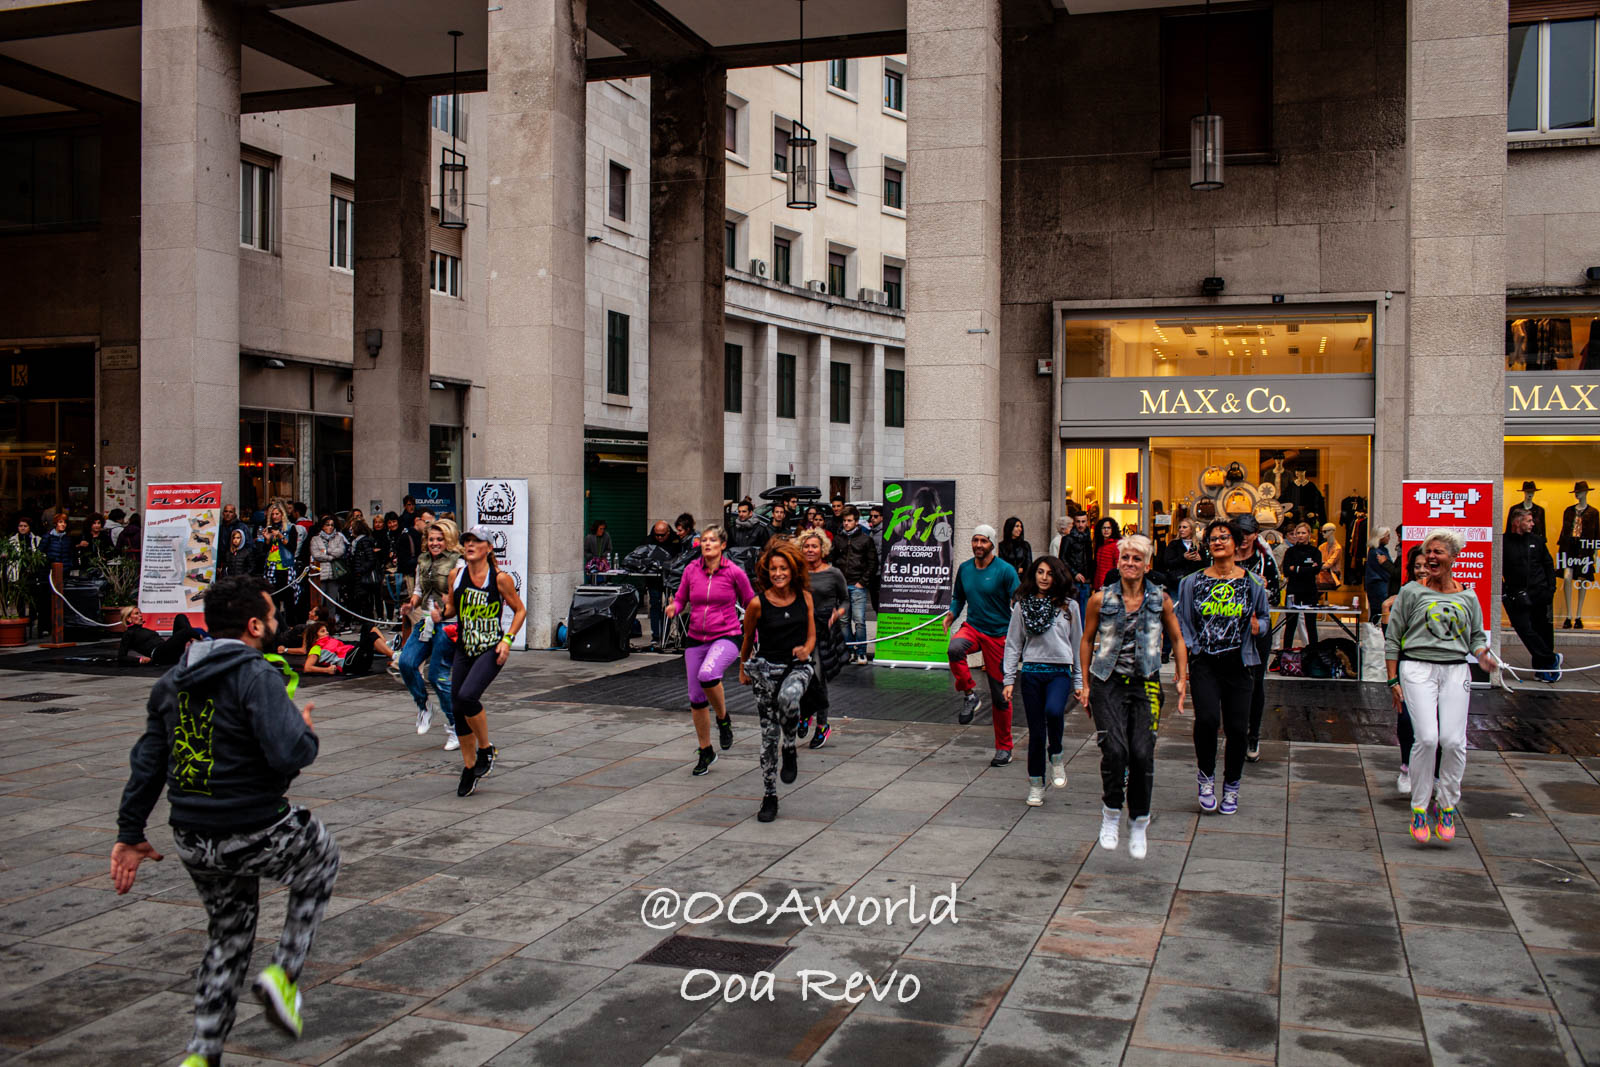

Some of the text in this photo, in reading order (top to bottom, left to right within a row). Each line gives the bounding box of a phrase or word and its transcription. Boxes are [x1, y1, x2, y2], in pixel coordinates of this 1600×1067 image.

[1139, 387, 1291, 414] MAX & Co.
[1508, 384, 1600, 411] MAX
[480, 513, 512, 521] AUDACE
[1467, 528, 1487, 540] GYM
[884, 563, 950, 576] 1€ al giorno
[1556, 552, 1594, 574] Hong
[883, 575, 903, 583] tutto
[464, 587, 490, 607] THE
[1201, 601, 1243, 616] ZUMBA
